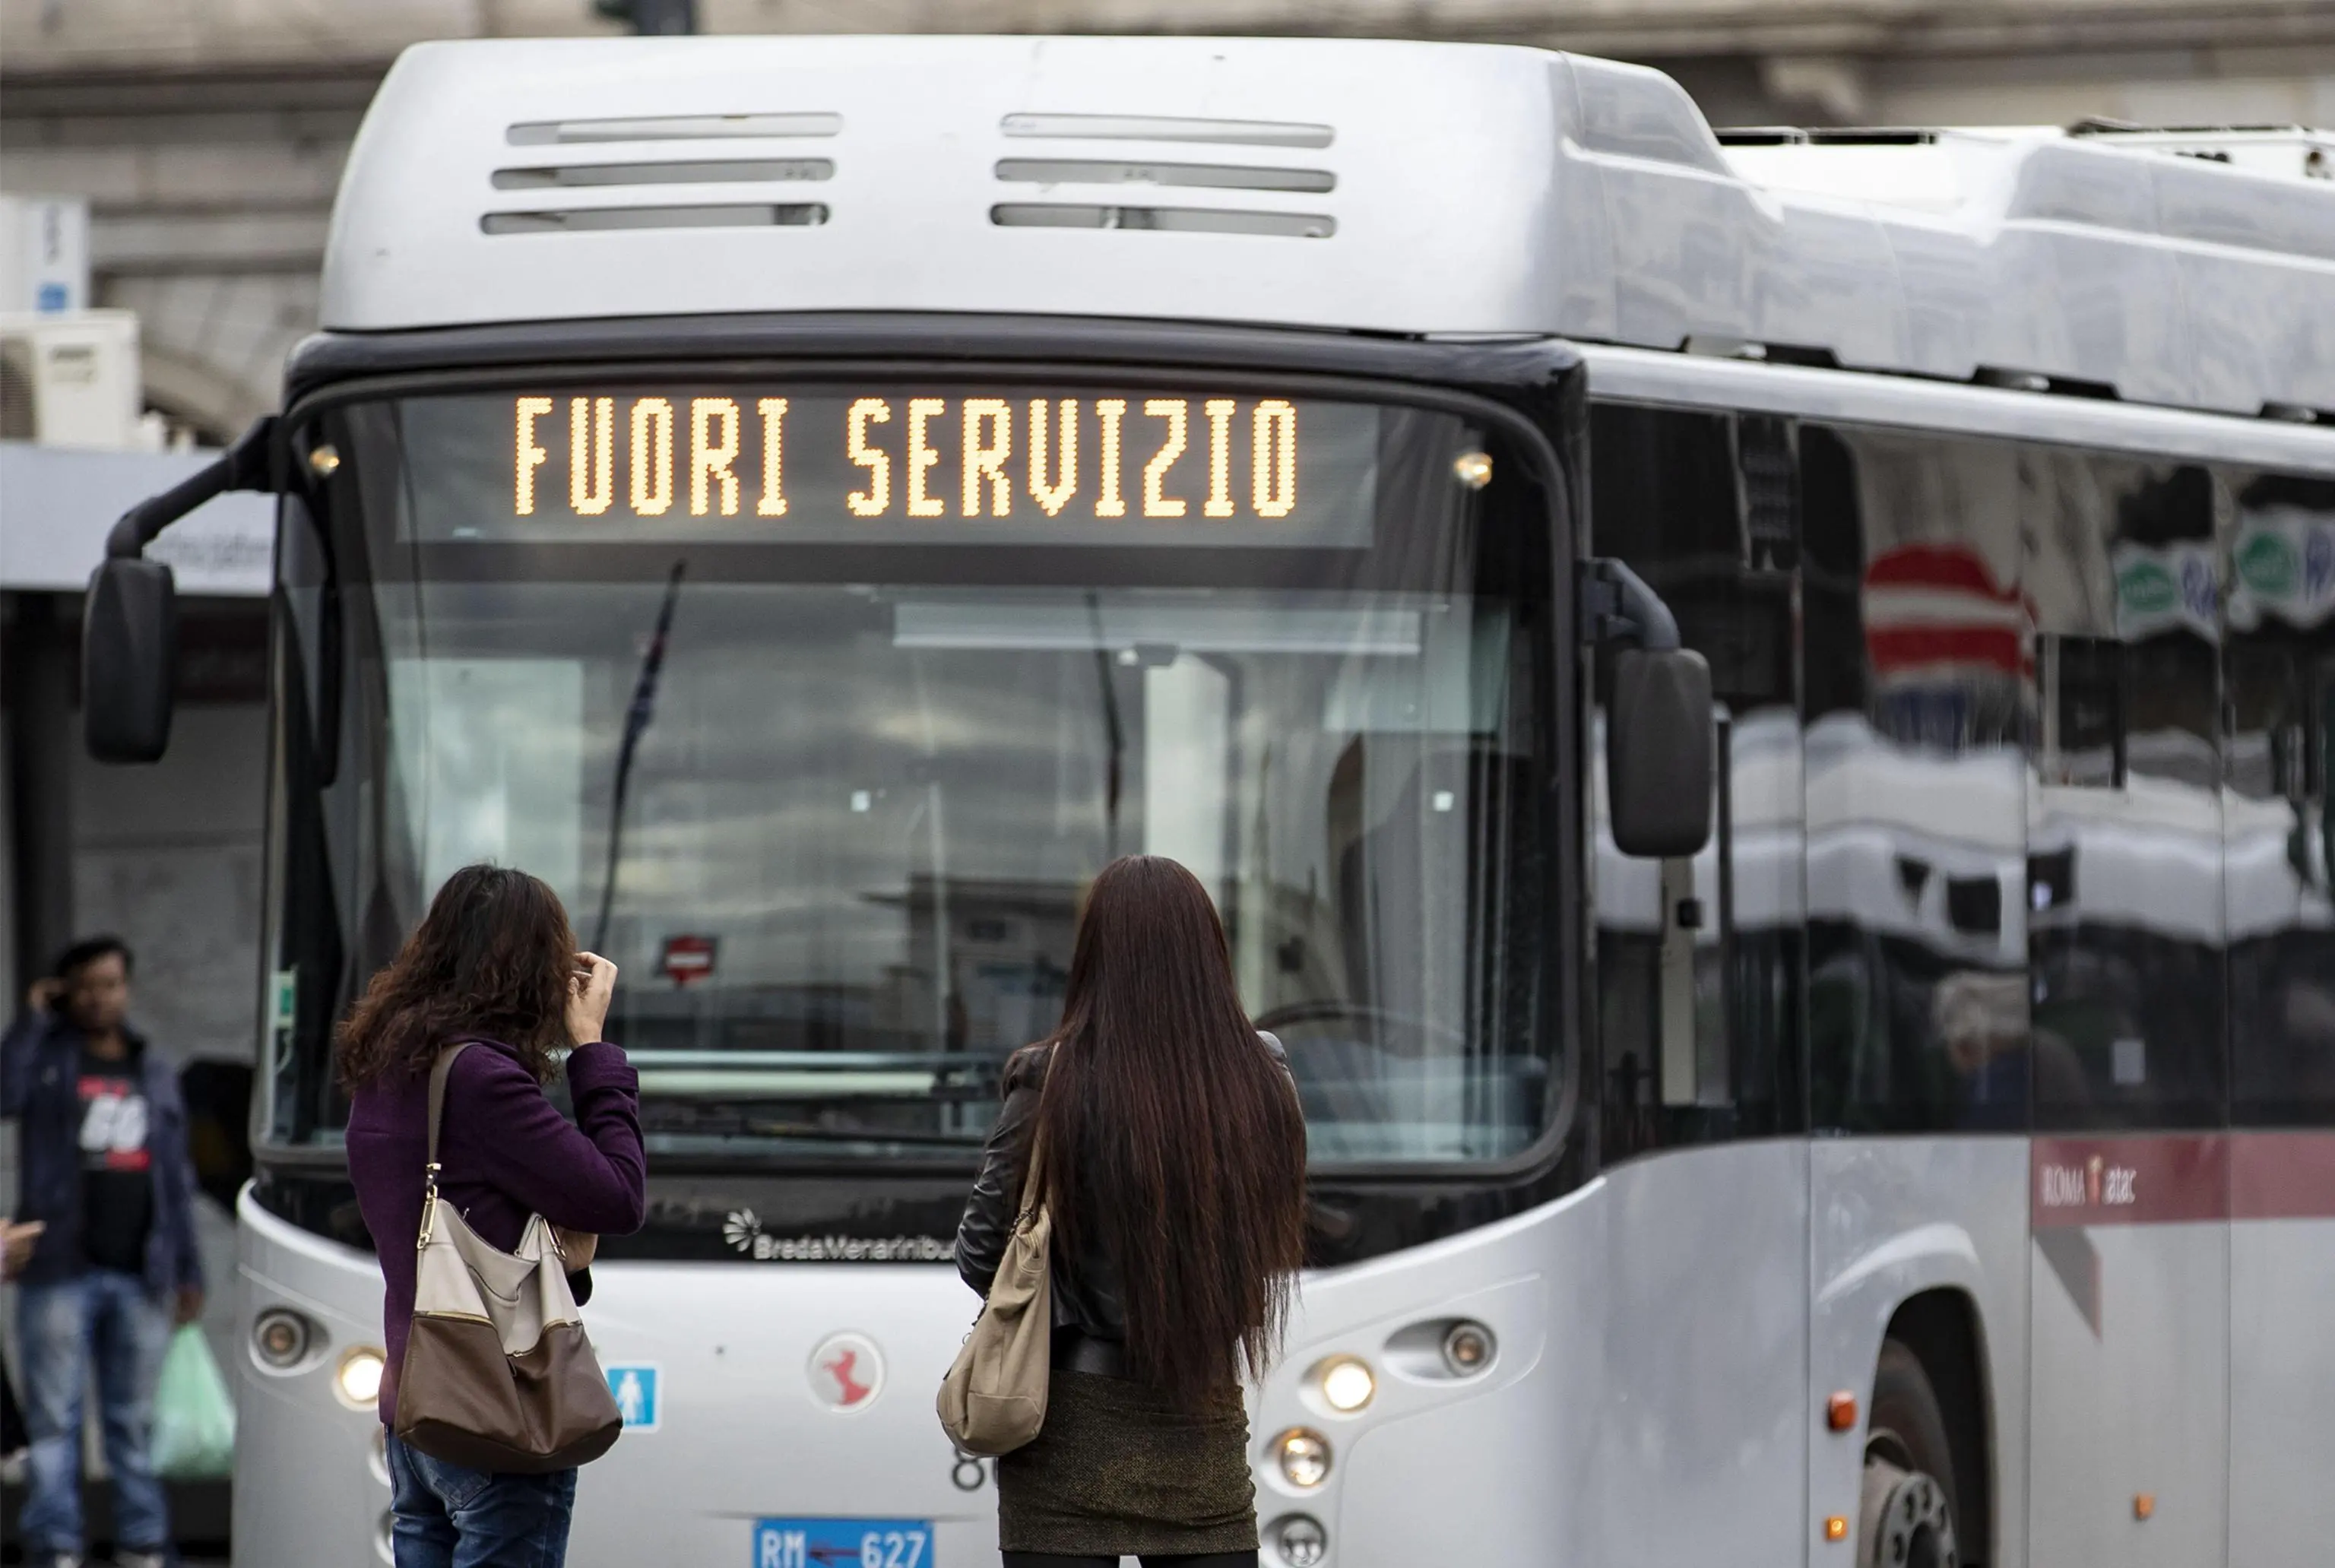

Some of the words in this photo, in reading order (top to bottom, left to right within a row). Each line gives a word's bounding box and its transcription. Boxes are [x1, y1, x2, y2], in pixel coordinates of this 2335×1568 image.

[515, 397, 788, 516] FUORI
[848, 398, 1297, 518] SERVIZIO
[2041, 1165, 2085, 1206] ROMA
[753, 1234, 955, 1259] BredaMenarinibu
[762, 1530, 806, 1568] RM
[860, 1532, 927, 1568] 627
